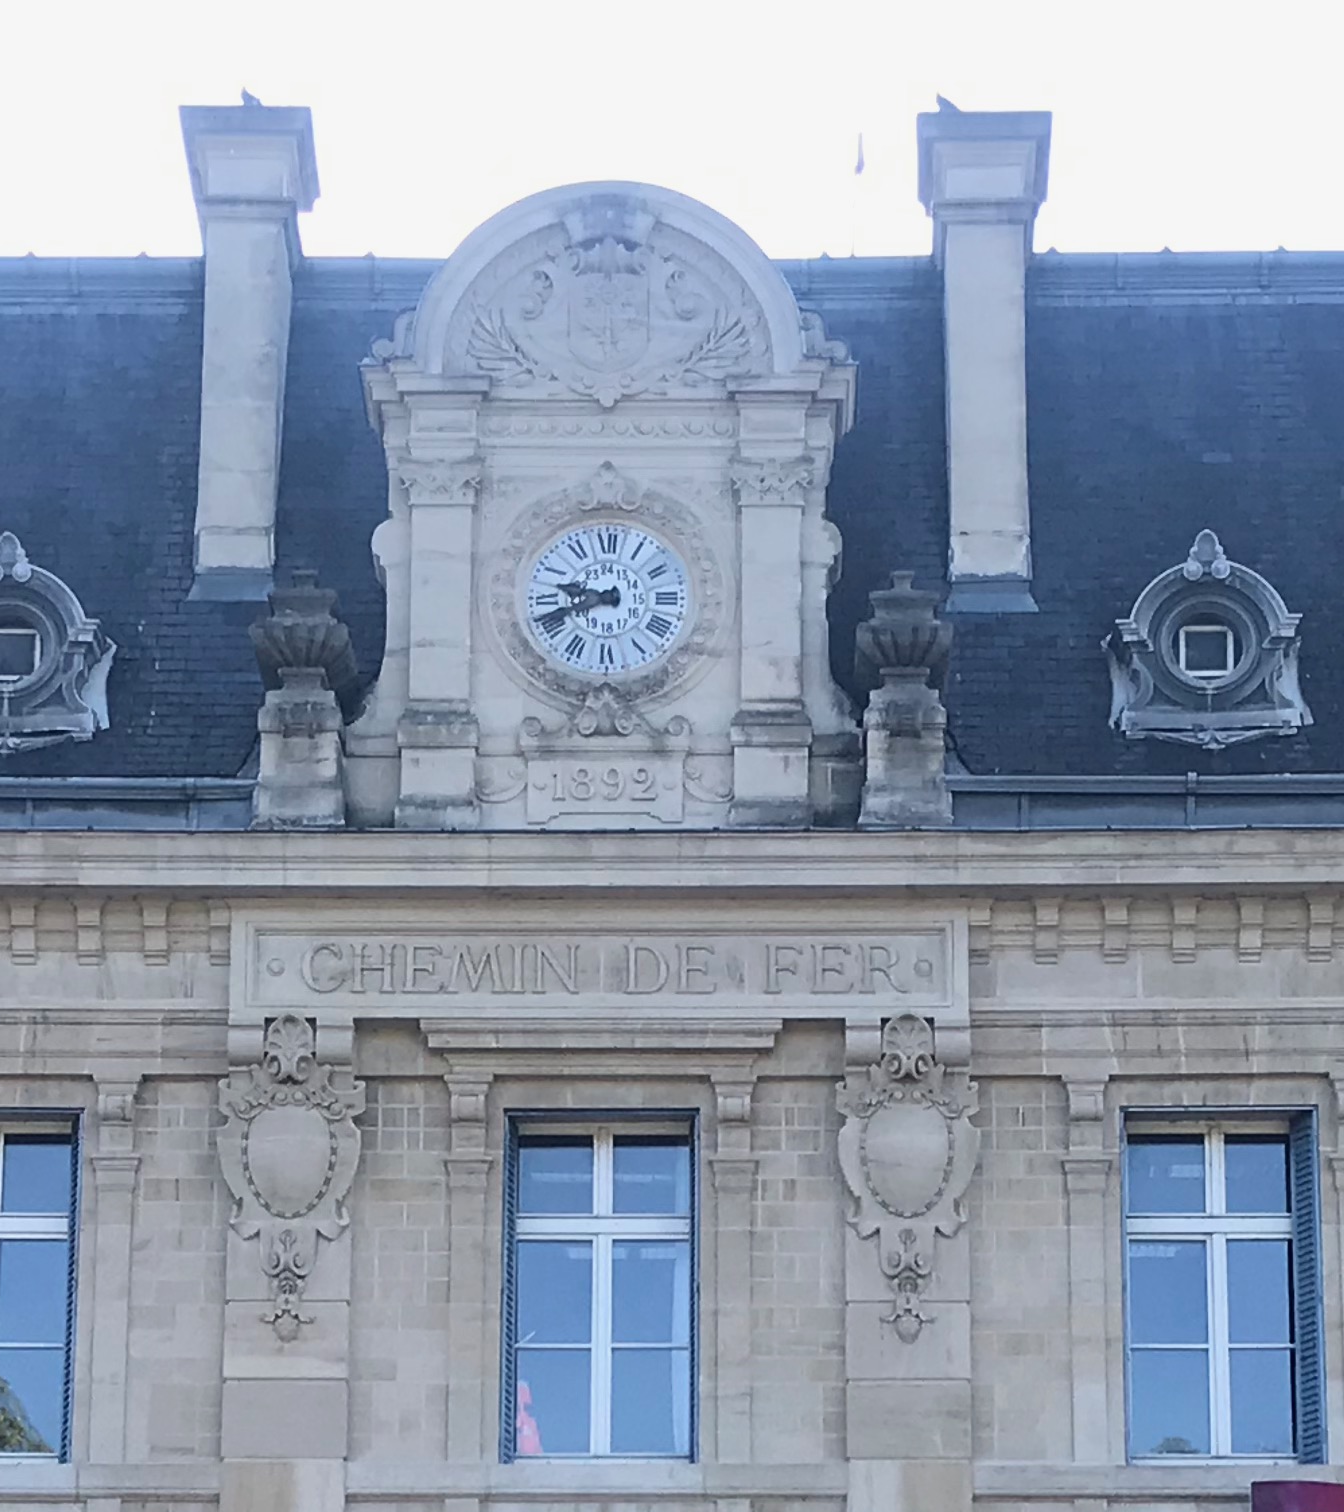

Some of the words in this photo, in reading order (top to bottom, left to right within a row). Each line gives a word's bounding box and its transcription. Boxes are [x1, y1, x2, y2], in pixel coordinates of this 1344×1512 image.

[601, 564, 614, 574] 24
[585, 570, 599, 580] 23
[617, 570, 628, 580] 13
[627, 579, 638, 590] 14
[633, 594, 645, 605] 15
[628, 608, 639, 619] 16
[586, 617, 597, 629] 19
[601, 622, 614, 633] 18
[617, 619, 628, 629] 17
[551, 767, 659, 802] 1892
[301, 941, 580, 995] CHEMIN
[622, 942, 719, 995] DE
[764, 943, 910, 995] FER
